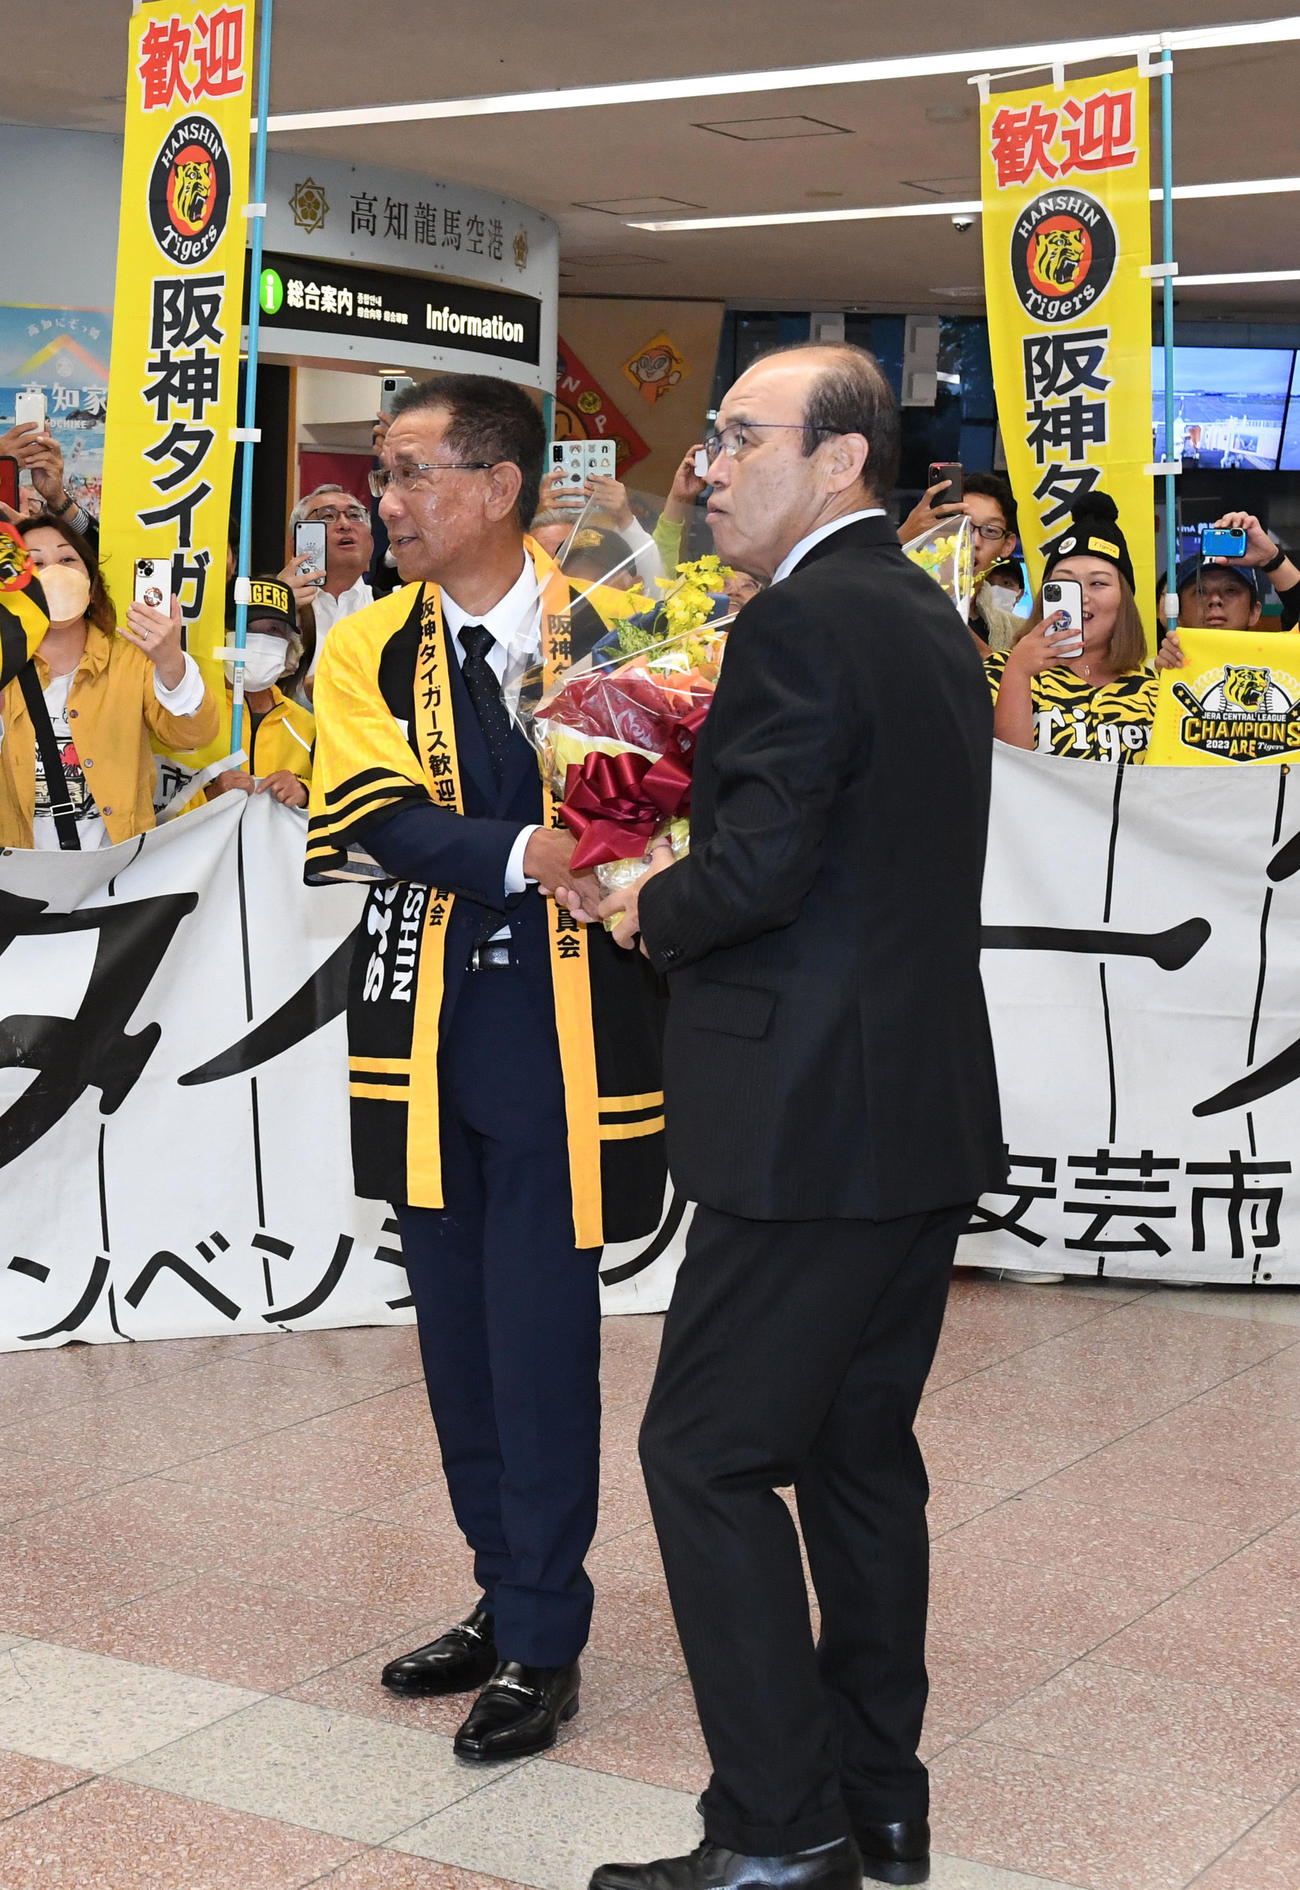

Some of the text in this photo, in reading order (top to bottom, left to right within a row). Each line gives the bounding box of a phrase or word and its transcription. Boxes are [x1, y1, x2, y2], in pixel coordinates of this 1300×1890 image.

[139, 7, 245, 109] 歓迎
[161, 123, 222, 169] HANSHIN
[991, 91, 1137, 188] 歓迎
[350, 192, 504, 261] 高知龍馬空港
[1018, 196, 1101, 239] HANSHIN
[161, 225, 218, 262] Tigers
[286, 279, 353, 316] 総合案内
[1025, 284, 1096, 320] Tigers
[426, 304, 524, 343] Information
[1022, 328, 1113, 557] 阪神タ
[1202, 711, 1287, 722] JERA CENTRAL LEAGUE
[1206, 740, 1284, 758] 2023 ARE Tigers
[958, 1148, 1292, 1258] 安芸市
